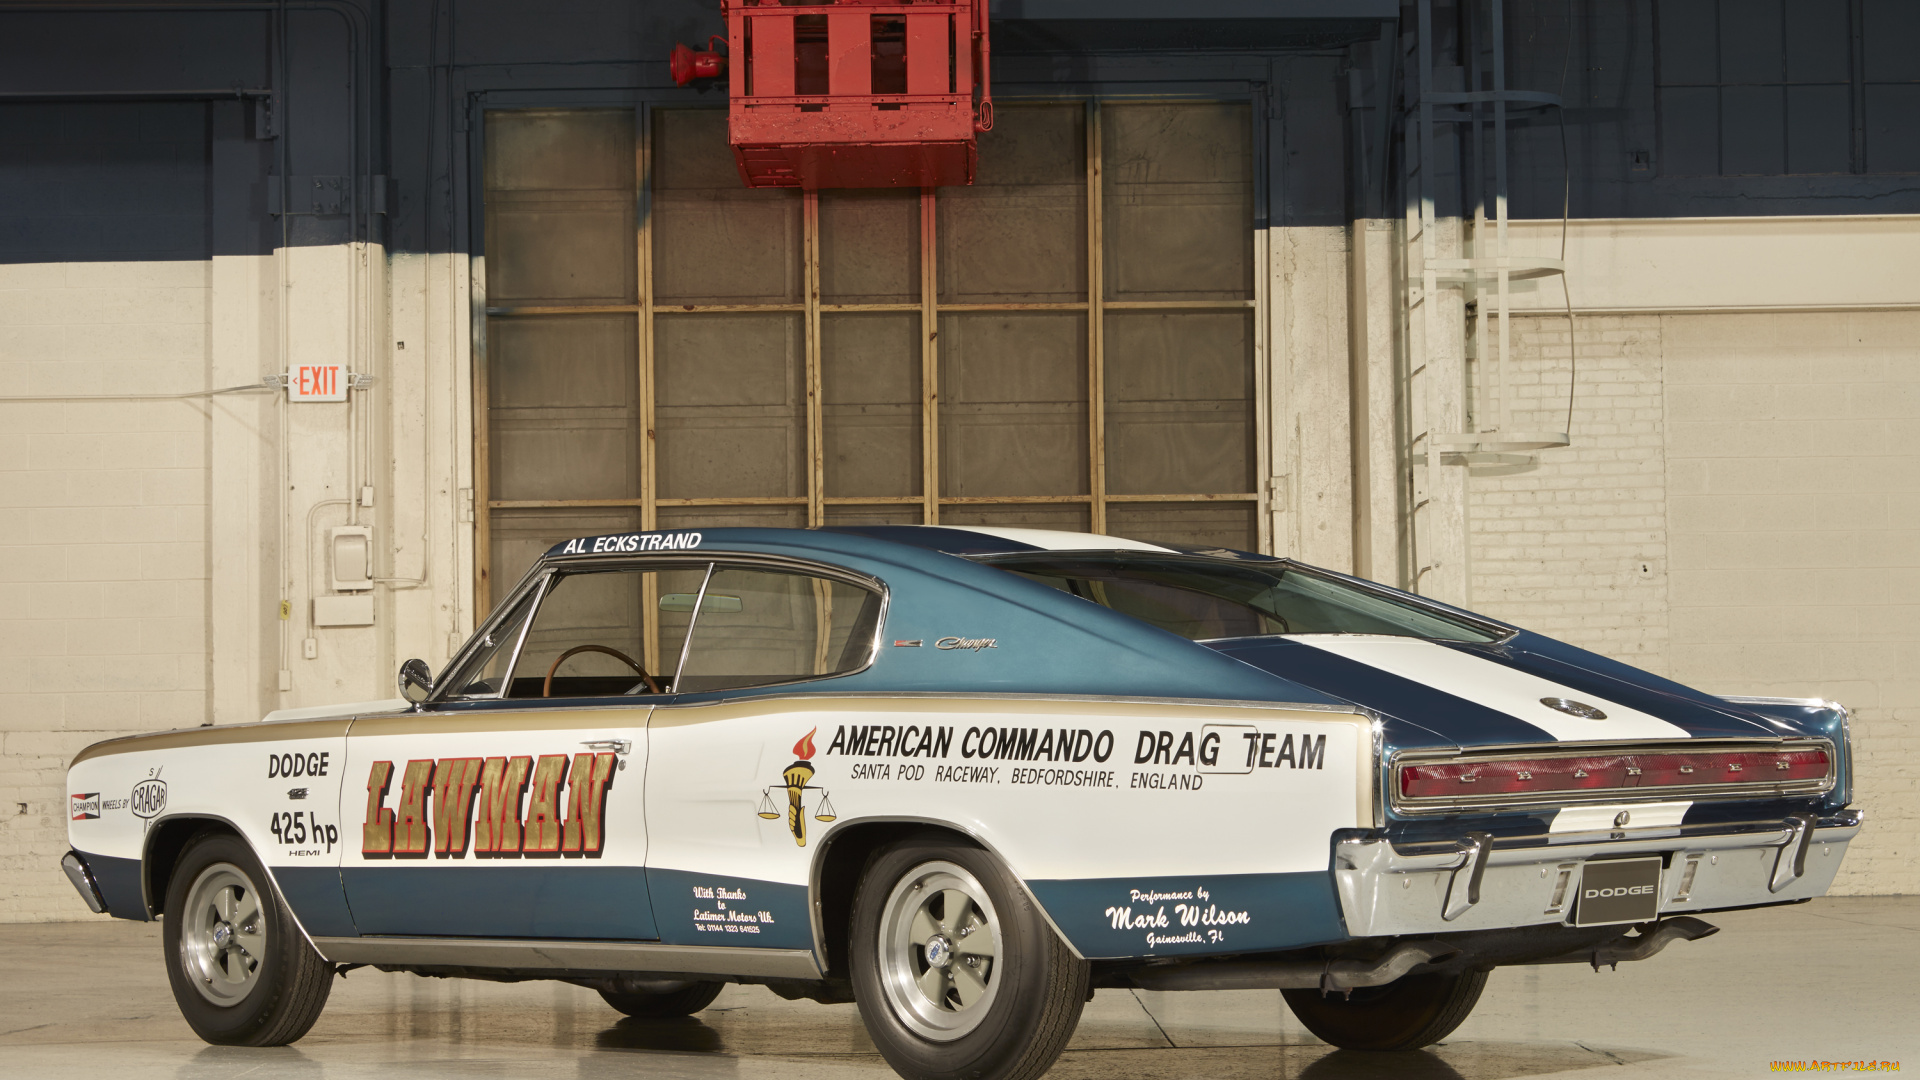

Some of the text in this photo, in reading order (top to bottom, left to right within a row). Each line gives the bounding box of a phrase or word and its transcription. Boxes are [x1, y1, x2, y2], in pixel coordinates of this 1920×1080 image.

[299, 366, 339, 395] EXIT
[563, 532, 702, 554] AL ECKSTRAND
[826, 725, 1327, 770] AMERICAN COMMANDO DRAG TEAM
[268, 752, 329, 778] DODGE
[851, 763, 891, 780] SANTA
[897, 764, 925, 781] POD
[1130, 772, 1203, 791] ENGLAND
[73, 801, 99, 812] CHAMPION
[102, 798, 129, 810] WHEELS BY
[133, 784, 165, 813] CRAGAR
[361, 752, 619, 859] LAWMAN
[271, 811, 338, 854] 425 hp
[288, 849, 320, 857] HEMI
[693, 886, 747, 900] With Thanks
[1129, 886, 1210, 905] Performance by
[1585, 884, 1654, 899] DODGE
[717, 900, 727, 910] to
[693, 908, 726, 922] Latimer
[727, 910, 757, 923] Motors
[1105, 903, 1251, 930] Mark Wilson
[1146, 931, 1206, 948] Gainesville,
